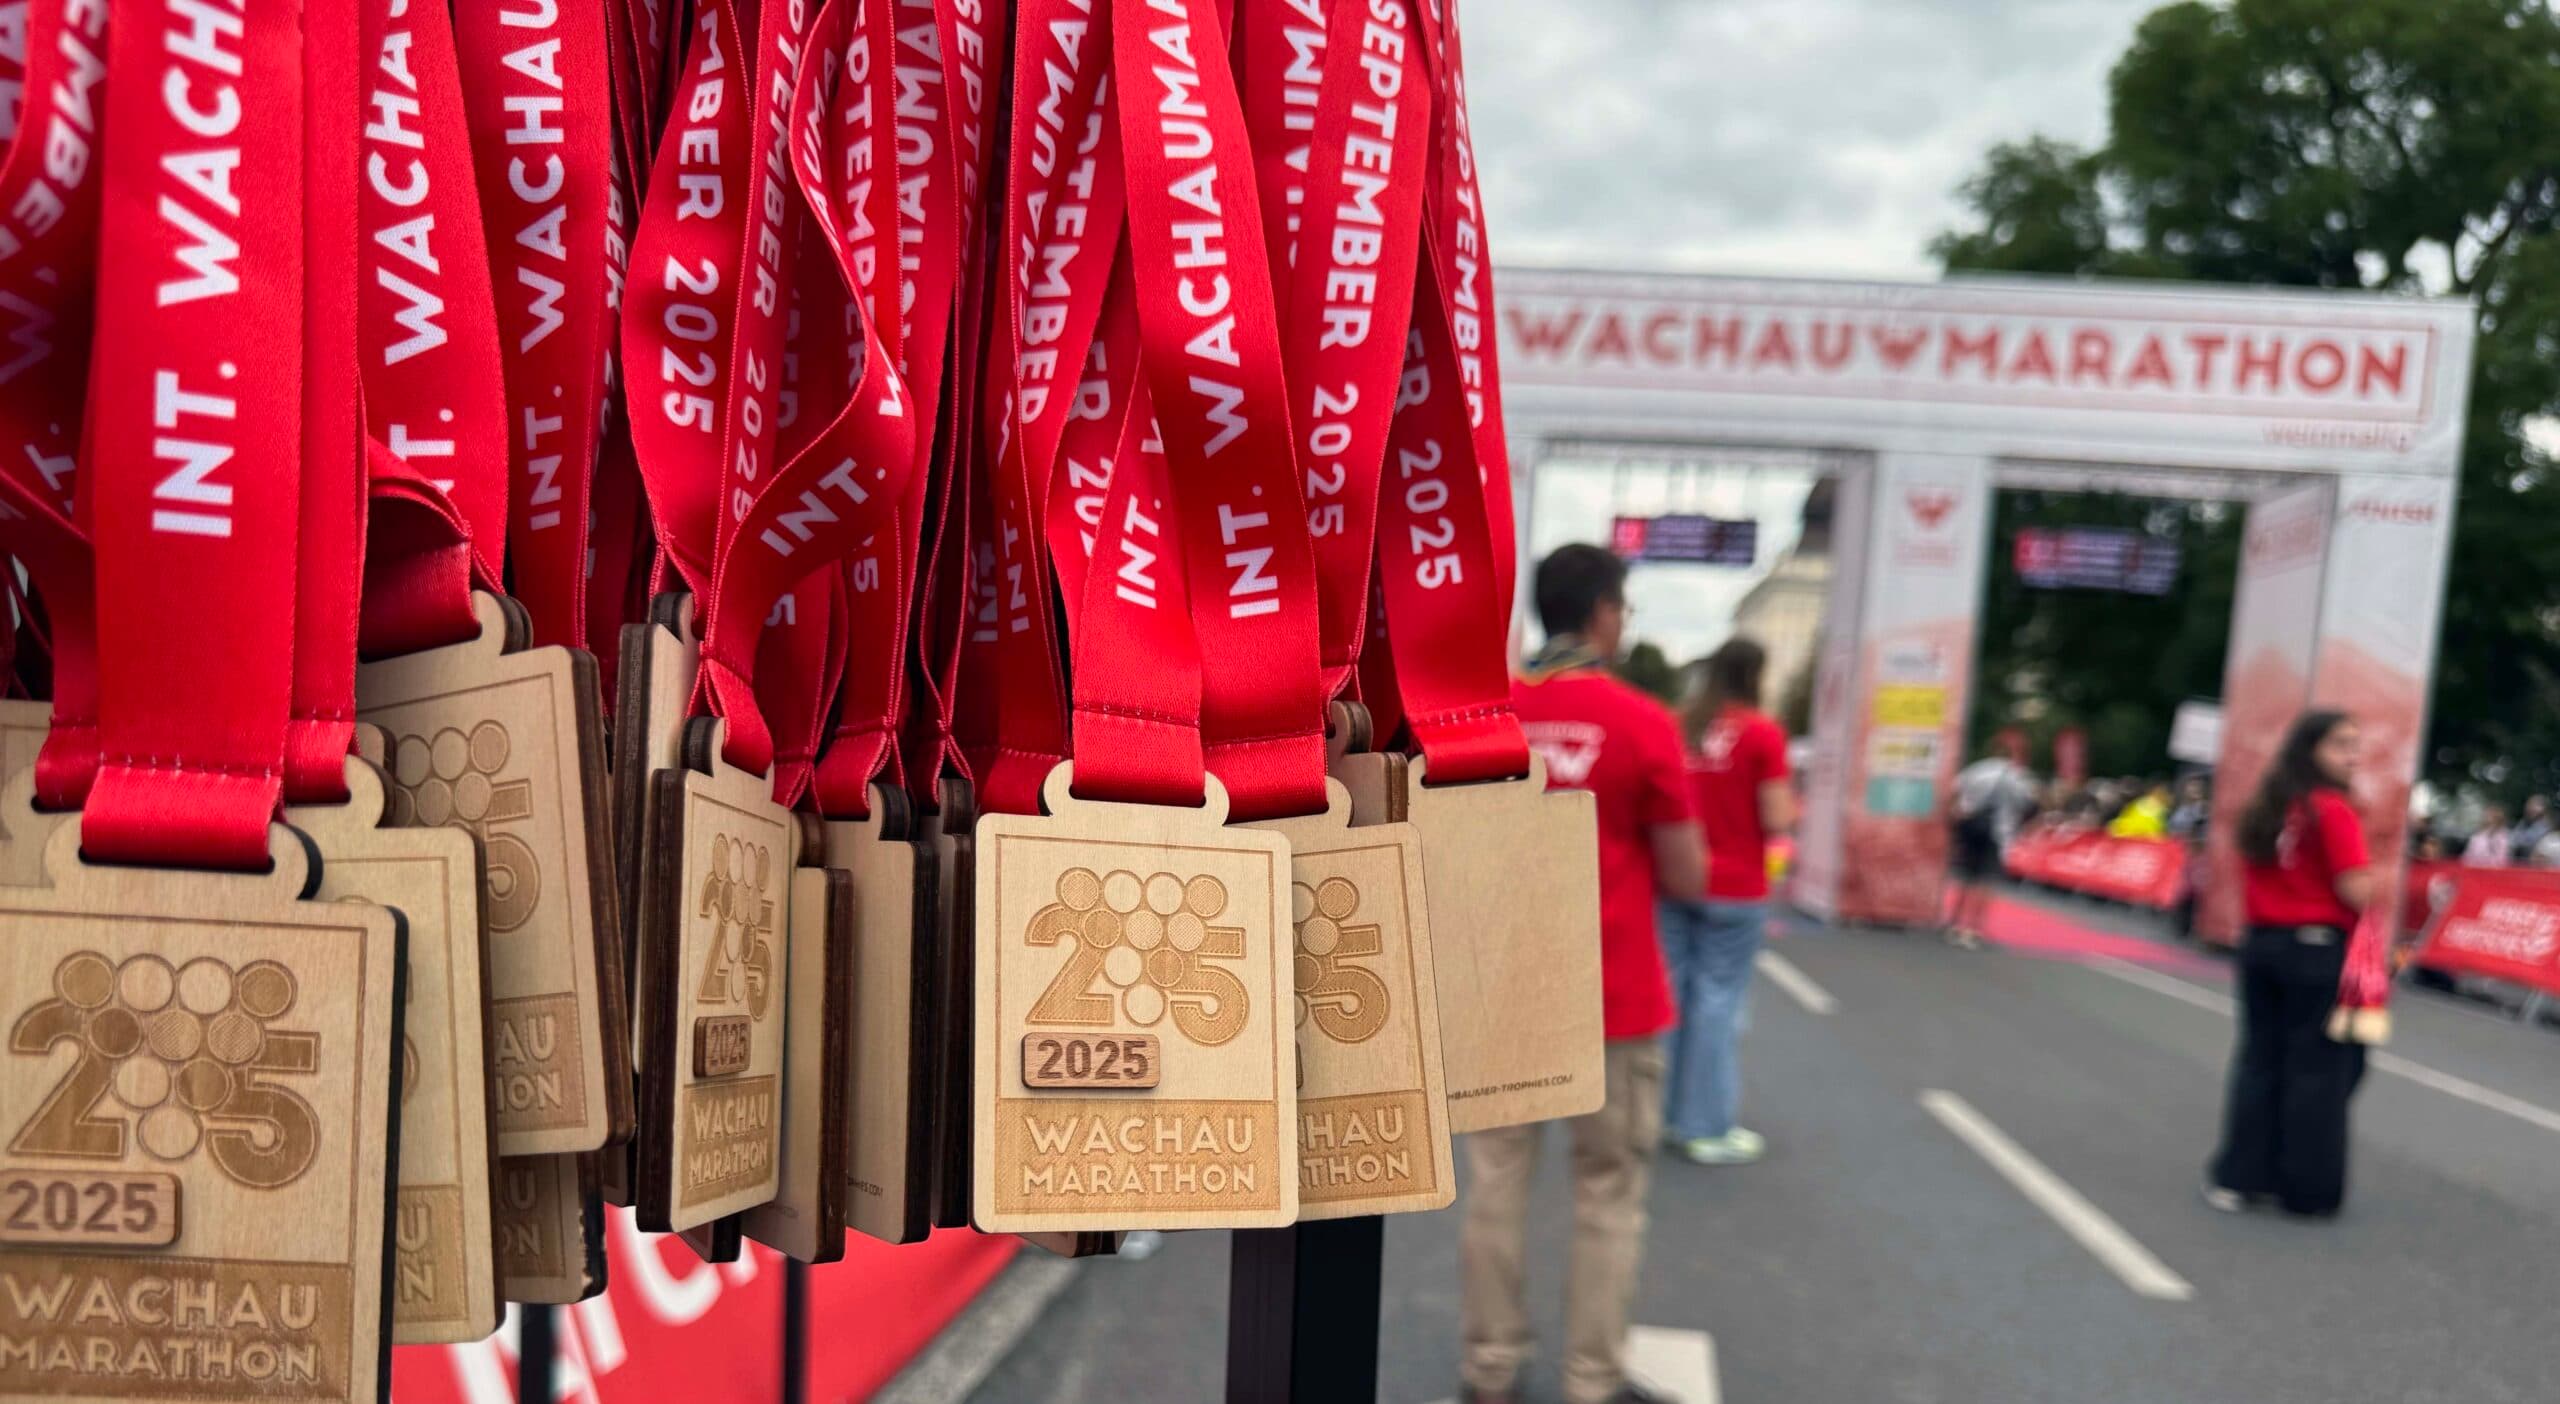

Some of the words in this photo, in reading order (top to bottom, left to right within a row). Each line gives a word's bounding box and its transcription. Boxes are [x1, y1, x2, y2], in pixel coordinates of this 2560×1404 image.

[156, 0, 245, 307] WACH
[676, 0, 724, 222] MBER
[1146, 0, 1248, 458] WACHAUMA
[663, 254, 720, 433] 2025
[1502, 304, 1857, 372] WACHAU
[1939, 322, 2411, 397] MARATHON
[151, 361, 238, 537] INT.
[525, 384, 563, 531] INT.
[1307, 382, 1360, 538] 2025
[760, 456, 887, 558] INT.
[1115, 495, 1163, 609] INT.
[1217, 483, 1280, 618] INT.
[1399, 439, 1464, 590] 2025
[708, 1021, 750, 1068] 2025
[1036, 1039, 1150, 1081] 2025
[687, 1136, 769, 1190] MARATHON
[691, 1091, 769, 1143] WACHAU
[1022, 1114, 1255, 1158] WACHAU
[1300, 1104, 1402, 1150] HAU
[3, 1179, 160, 1234] 2025
[1022, 1159, 1256, 1195] MARATHON
[1297, 1150, 1411, 1188] THON
[4, 1274, 320, 1332] WACHAU
[0, 1336, 320, 1384] MARATHON
